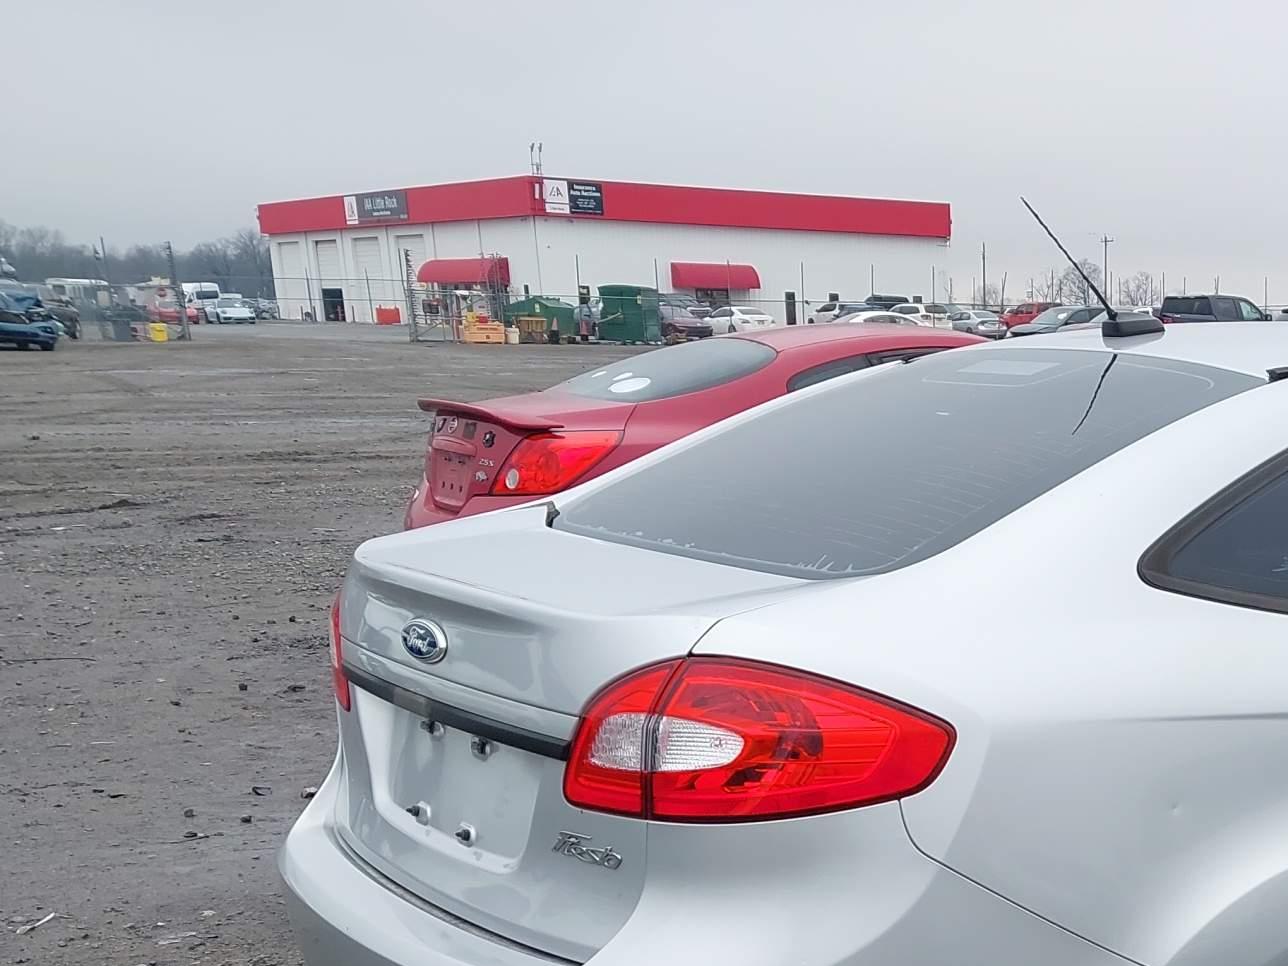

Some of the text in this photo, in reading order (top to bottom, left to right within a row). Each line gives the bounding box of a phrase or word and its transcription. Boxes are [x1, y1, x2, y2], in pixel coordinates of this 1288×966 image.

[385, 196, 398, 208] Rock
[406, 625, 431, 652] Ford
[553, 830, 622, 870] Fiesta
